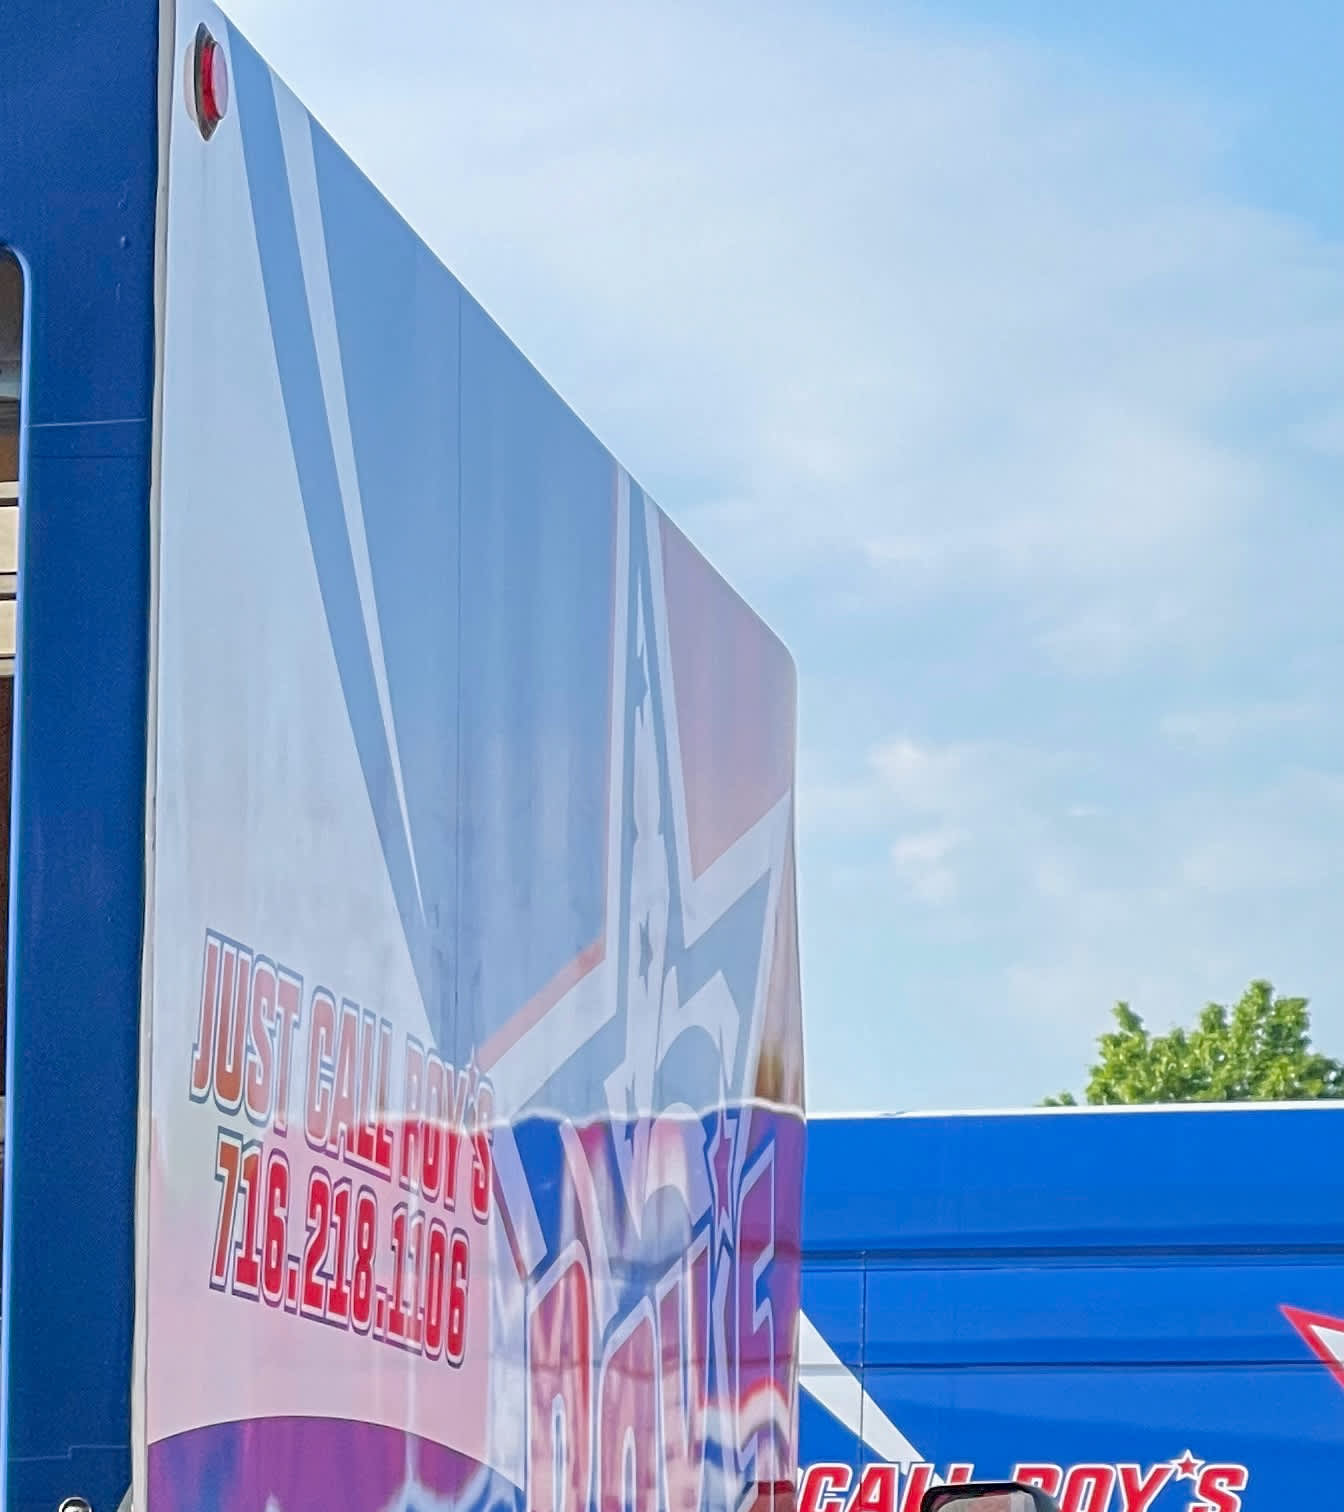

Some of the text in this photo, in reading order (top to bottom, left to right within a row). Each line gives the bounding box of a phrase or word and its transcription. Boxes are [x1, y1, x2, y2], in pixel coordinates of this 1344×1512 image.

[190, 928, 496, 1226] JUST CALL ROY'S
[209, 1126, 471, 1370] 716.218.1106
